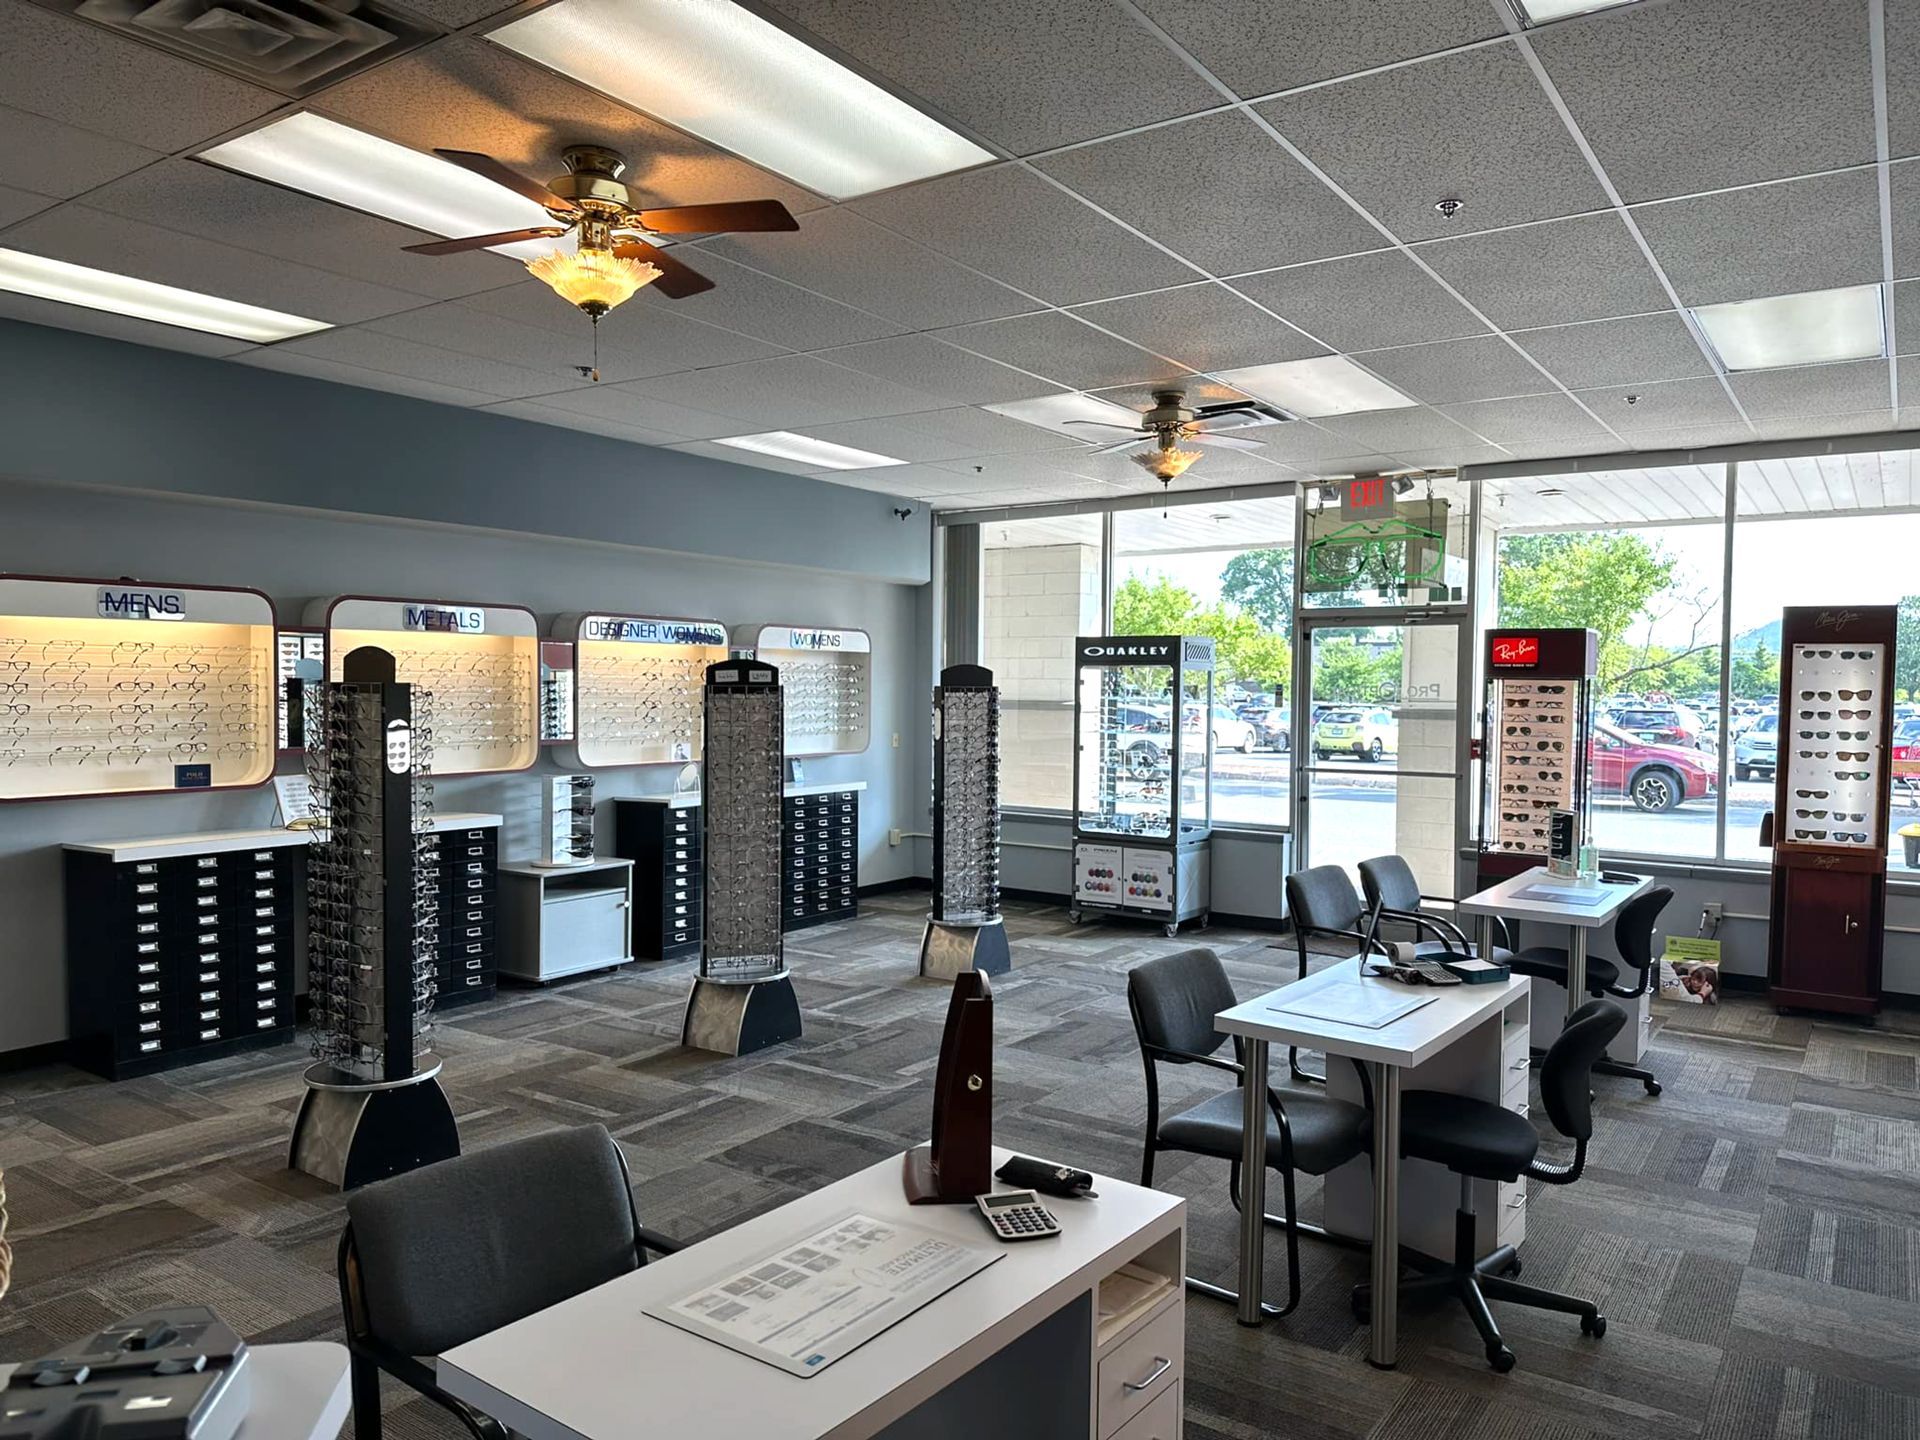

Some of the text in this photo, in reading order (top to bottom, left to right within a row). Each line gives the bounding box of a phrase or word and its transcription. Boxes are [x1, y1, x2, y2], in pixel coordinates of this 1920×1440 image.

[1351, 480, 1384, 508] EXIT
[105, 592, 179, 614] MENS
[408, 609, 480, 629] METALS
[589, 621, 721, 641] DESIGNER WOMENS
[793, 631, 841, 648] WOMENS
[1106, 646, 1168, 655] OAKLEY
[1495, 639, 1536, 660] Ray-Ban
